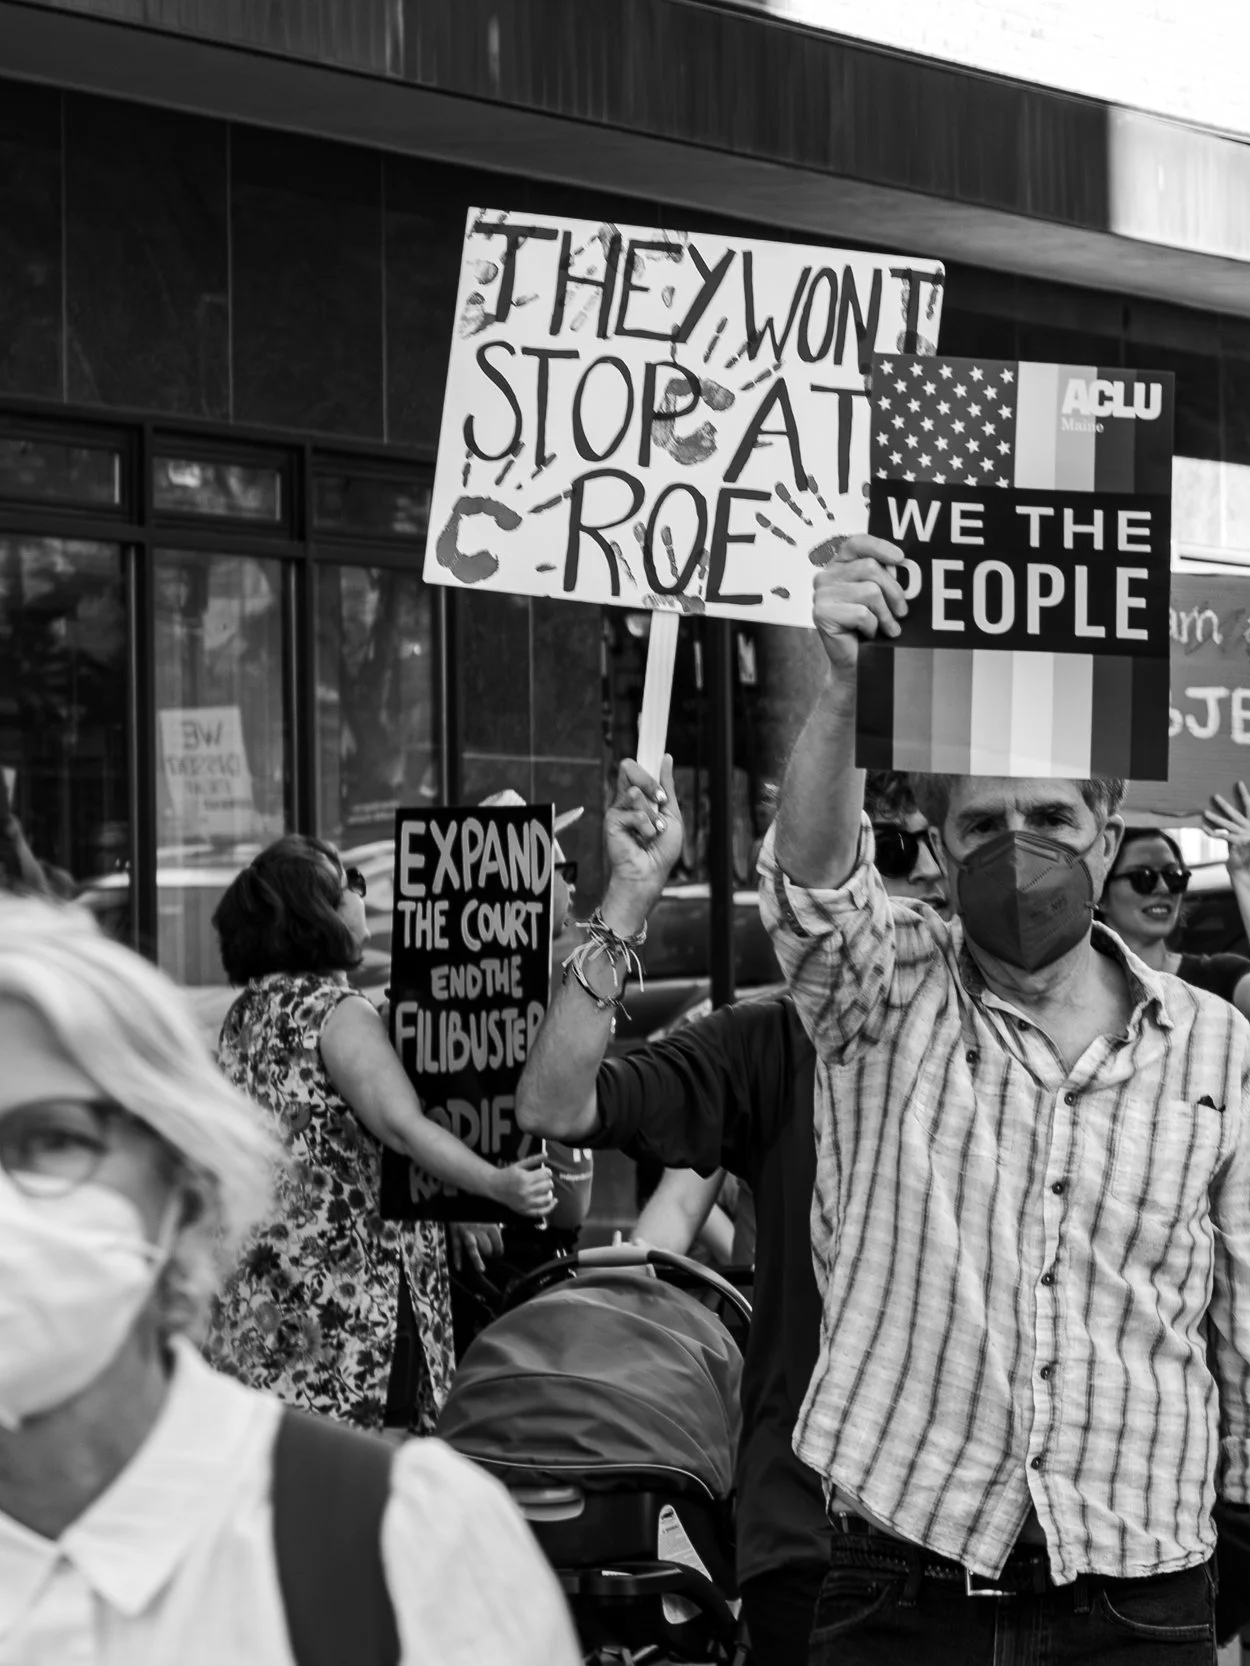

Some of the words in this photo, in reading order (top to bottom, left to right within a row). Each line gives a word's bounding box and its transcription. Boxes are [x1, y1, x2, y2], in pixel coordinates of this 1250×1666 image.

[473, 221, 737, 344] THEY
[463, 340, 701, 467] STOP
[723, 377, 871, 493] AT
[1061, 378, 1162, 421] ACLU
[1061, 417, 1104, 433] Maine
[563, 468, 772, 605] ROE
[887, 497, 986, 546] WE
[1015, 505, 1153, 553] THE
[399, 817, 552, 897] EXPAND
[398, 900, 449, 950] THE
[461, 898, 543, 951] COURT
[431, 963, 481, 1000] END
[481, 955, 523, 998] THE
